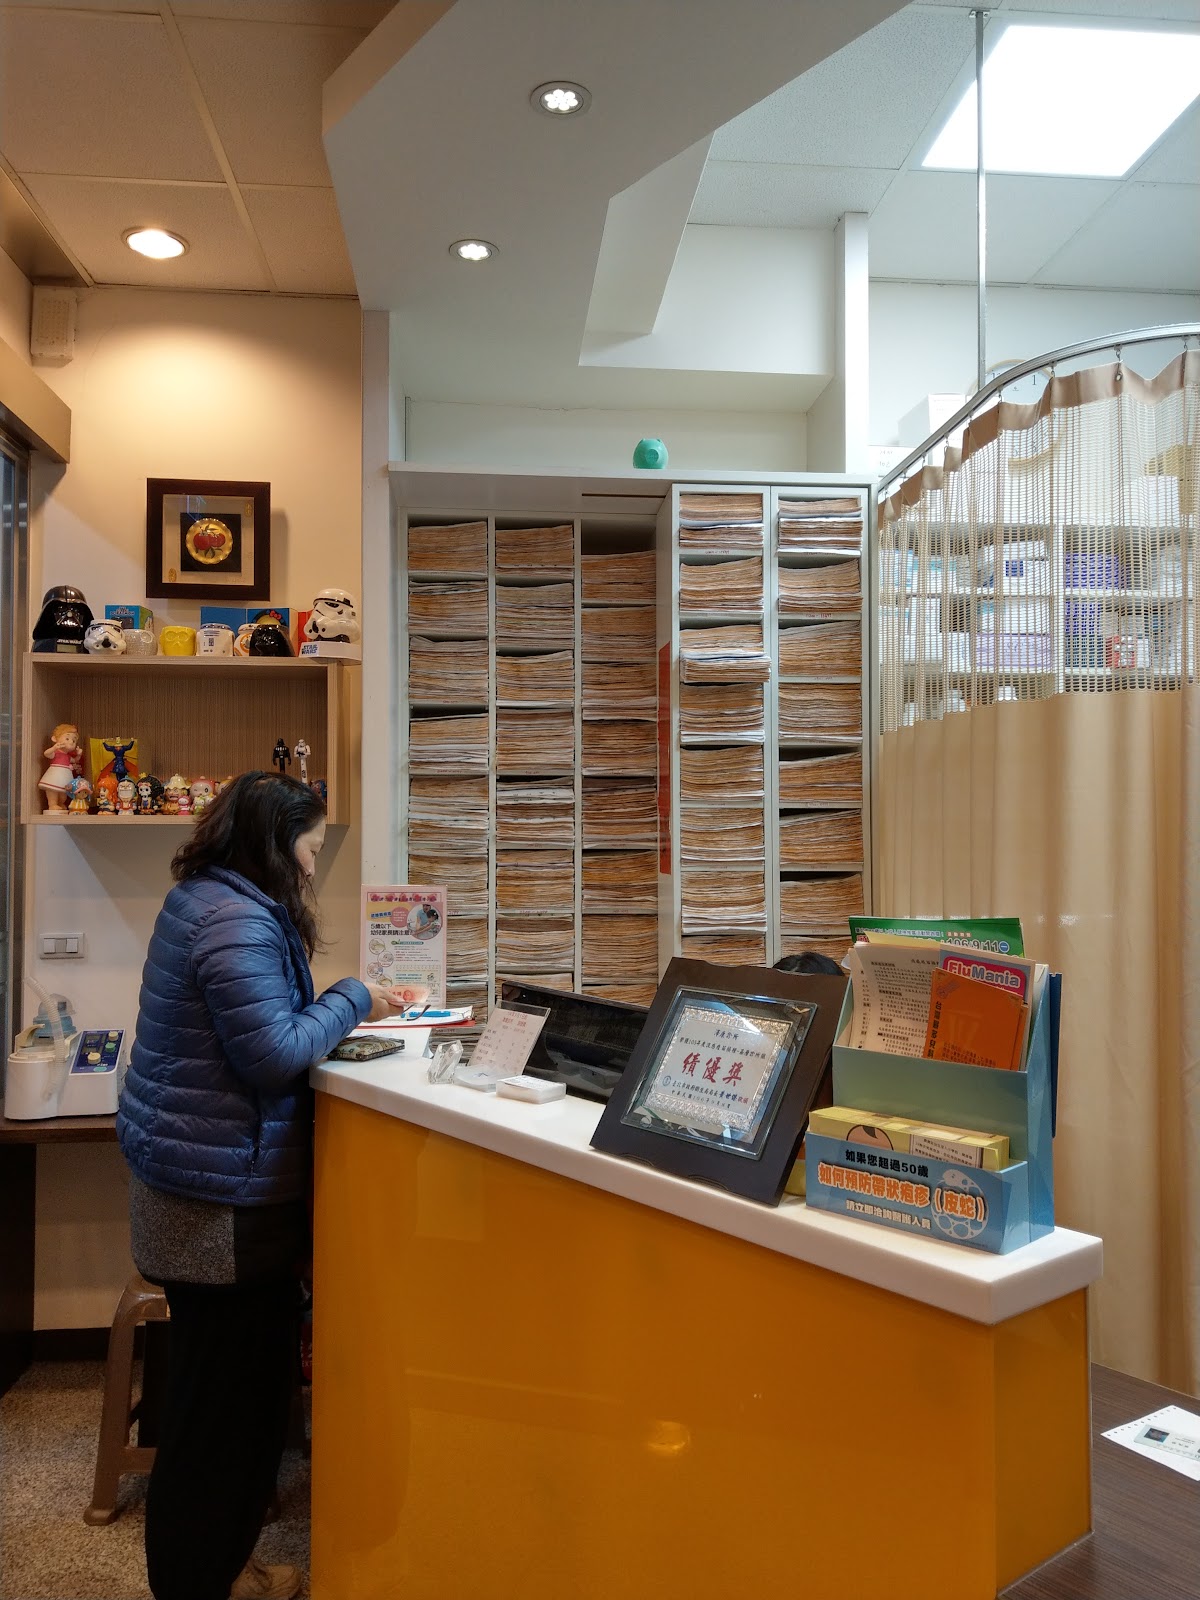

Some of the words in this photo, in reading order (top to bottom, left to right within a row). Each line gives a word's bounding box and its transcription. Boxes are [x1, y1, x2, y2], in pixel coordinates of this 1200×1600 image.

[948, 960, 1020, 988] FluMania
[682, 1052, 744, 1087] 績優獎
[845, 1149, 929, 1178] 如果您超過50歲
[846, 1199, 931, 1230] 請立即洽詢醫護人員
